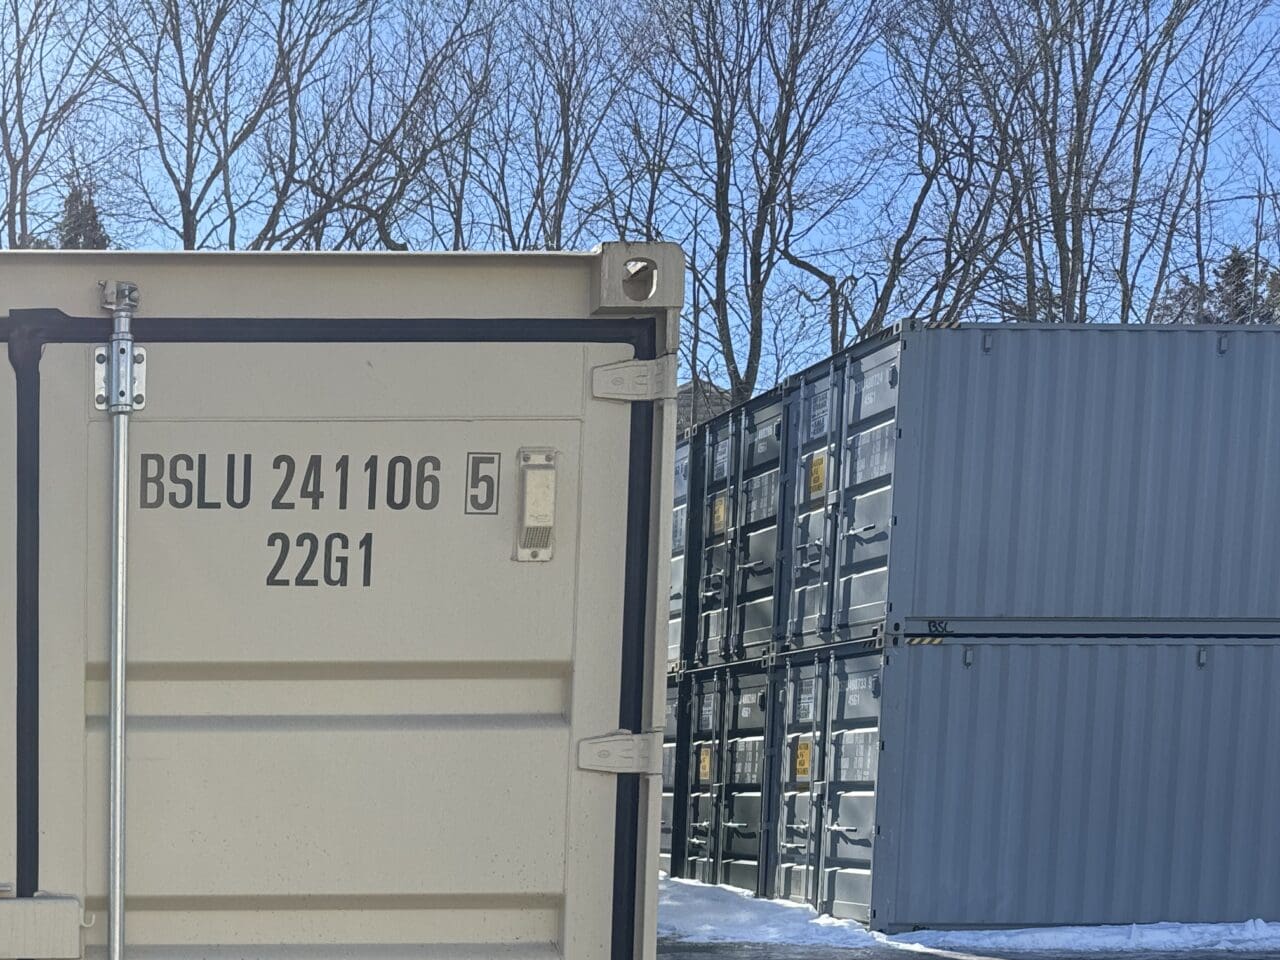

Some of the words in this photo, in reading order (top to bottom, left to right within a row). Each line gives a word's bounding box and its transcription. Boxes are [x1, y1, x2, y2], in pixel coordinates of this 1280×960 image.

[139, 453, 252, 509] BSLU
[271, 454, 441, 510] 241106
[470, 456, 495, 511] 5
[266, 532, 373, 587] 22G1
